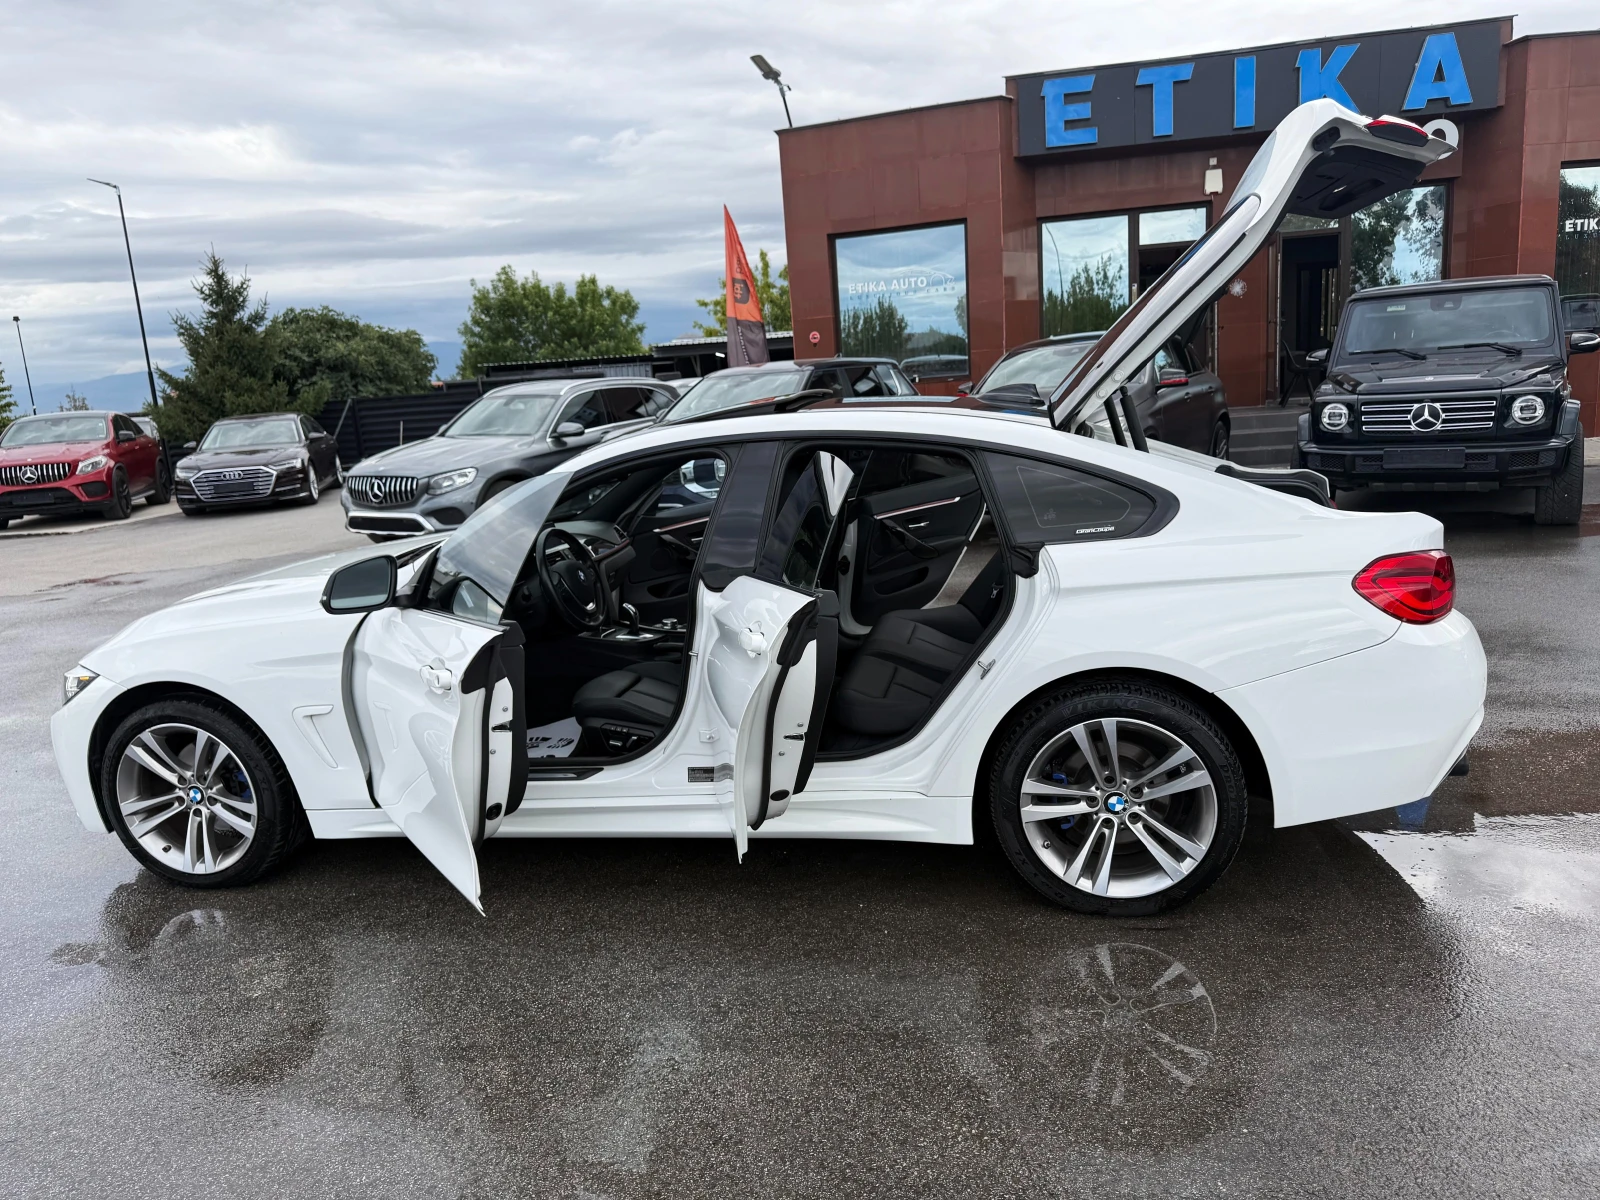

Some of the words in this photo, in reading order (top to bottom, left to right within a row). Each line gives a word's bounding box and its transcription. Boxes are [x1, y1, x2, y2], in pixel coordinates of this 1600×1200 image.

[1041, 32, 1473, 148] ETIKA
[1565, 218, 1600, 232] ETIK
[849, 281, 887, 294] ETIKA
[891, 277, 927, 290] AUTO
